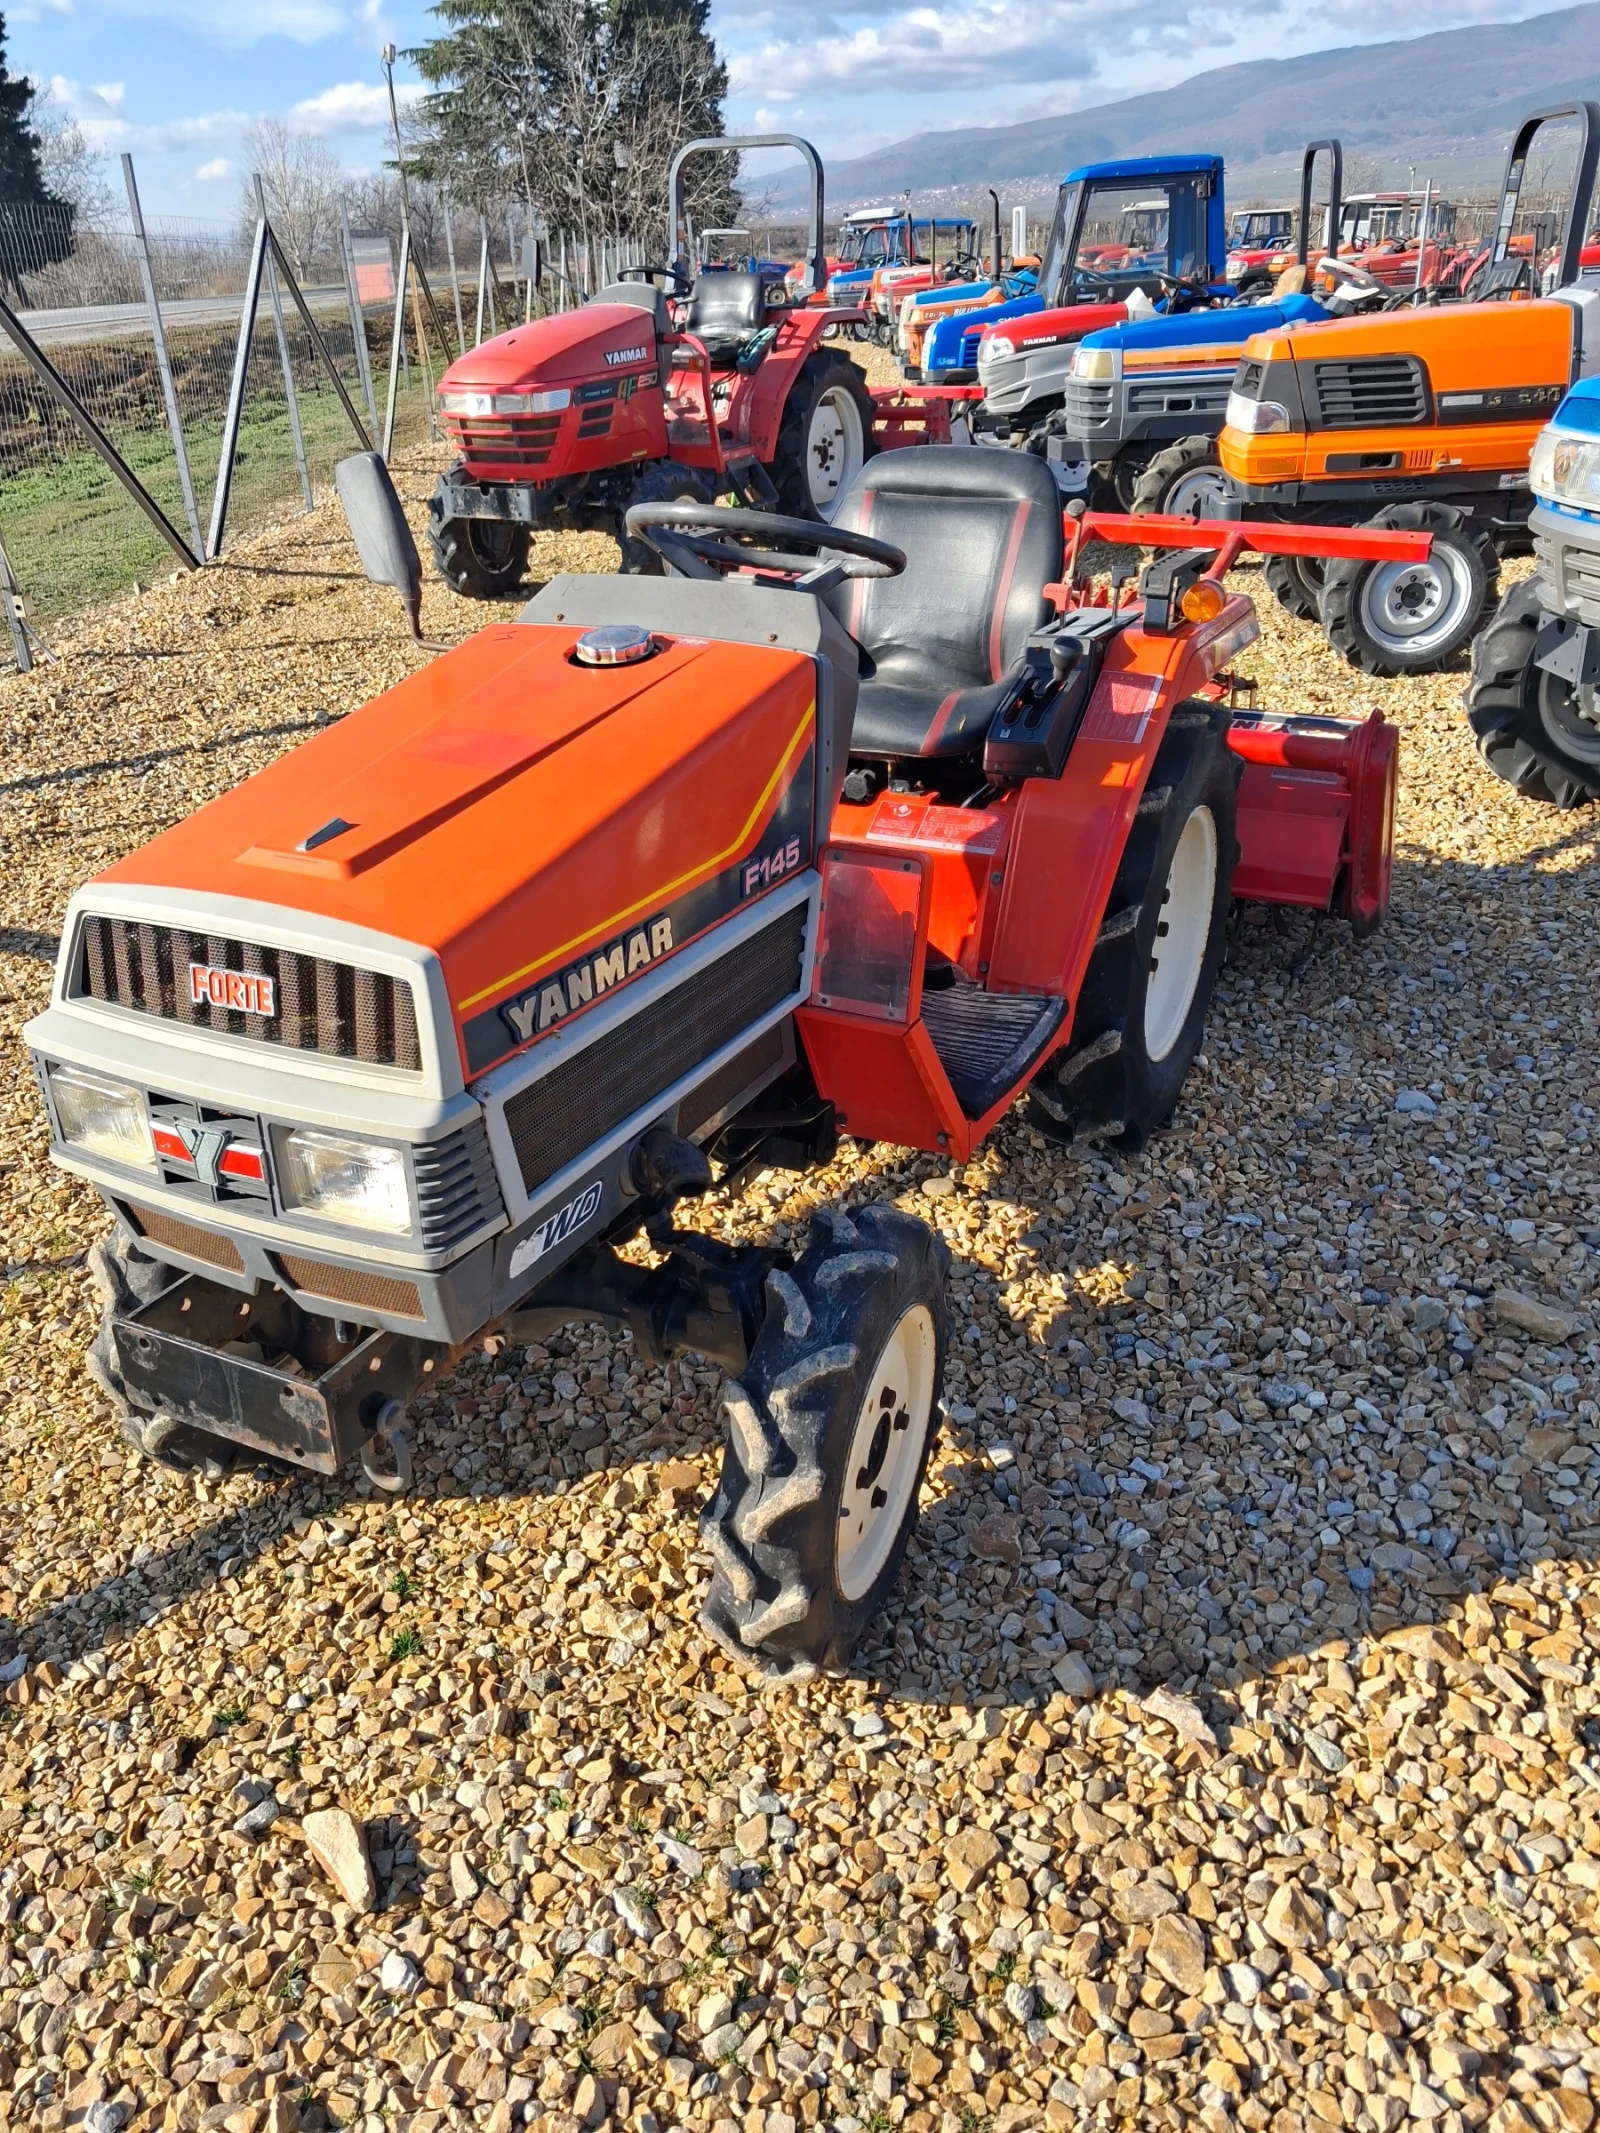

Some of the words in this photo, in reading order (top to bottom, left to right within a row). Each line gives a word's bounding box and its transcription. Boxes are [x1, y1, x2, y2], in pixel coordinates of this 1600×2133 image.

[605, 346, 647, 366] YANMAR
[1022, 335, 1058, 346] YANMAR
[743, 838, 802, 897] F145
[190, 963, 276, 1017] FORTE
[505, 914, 674, 1043] YANMAR
